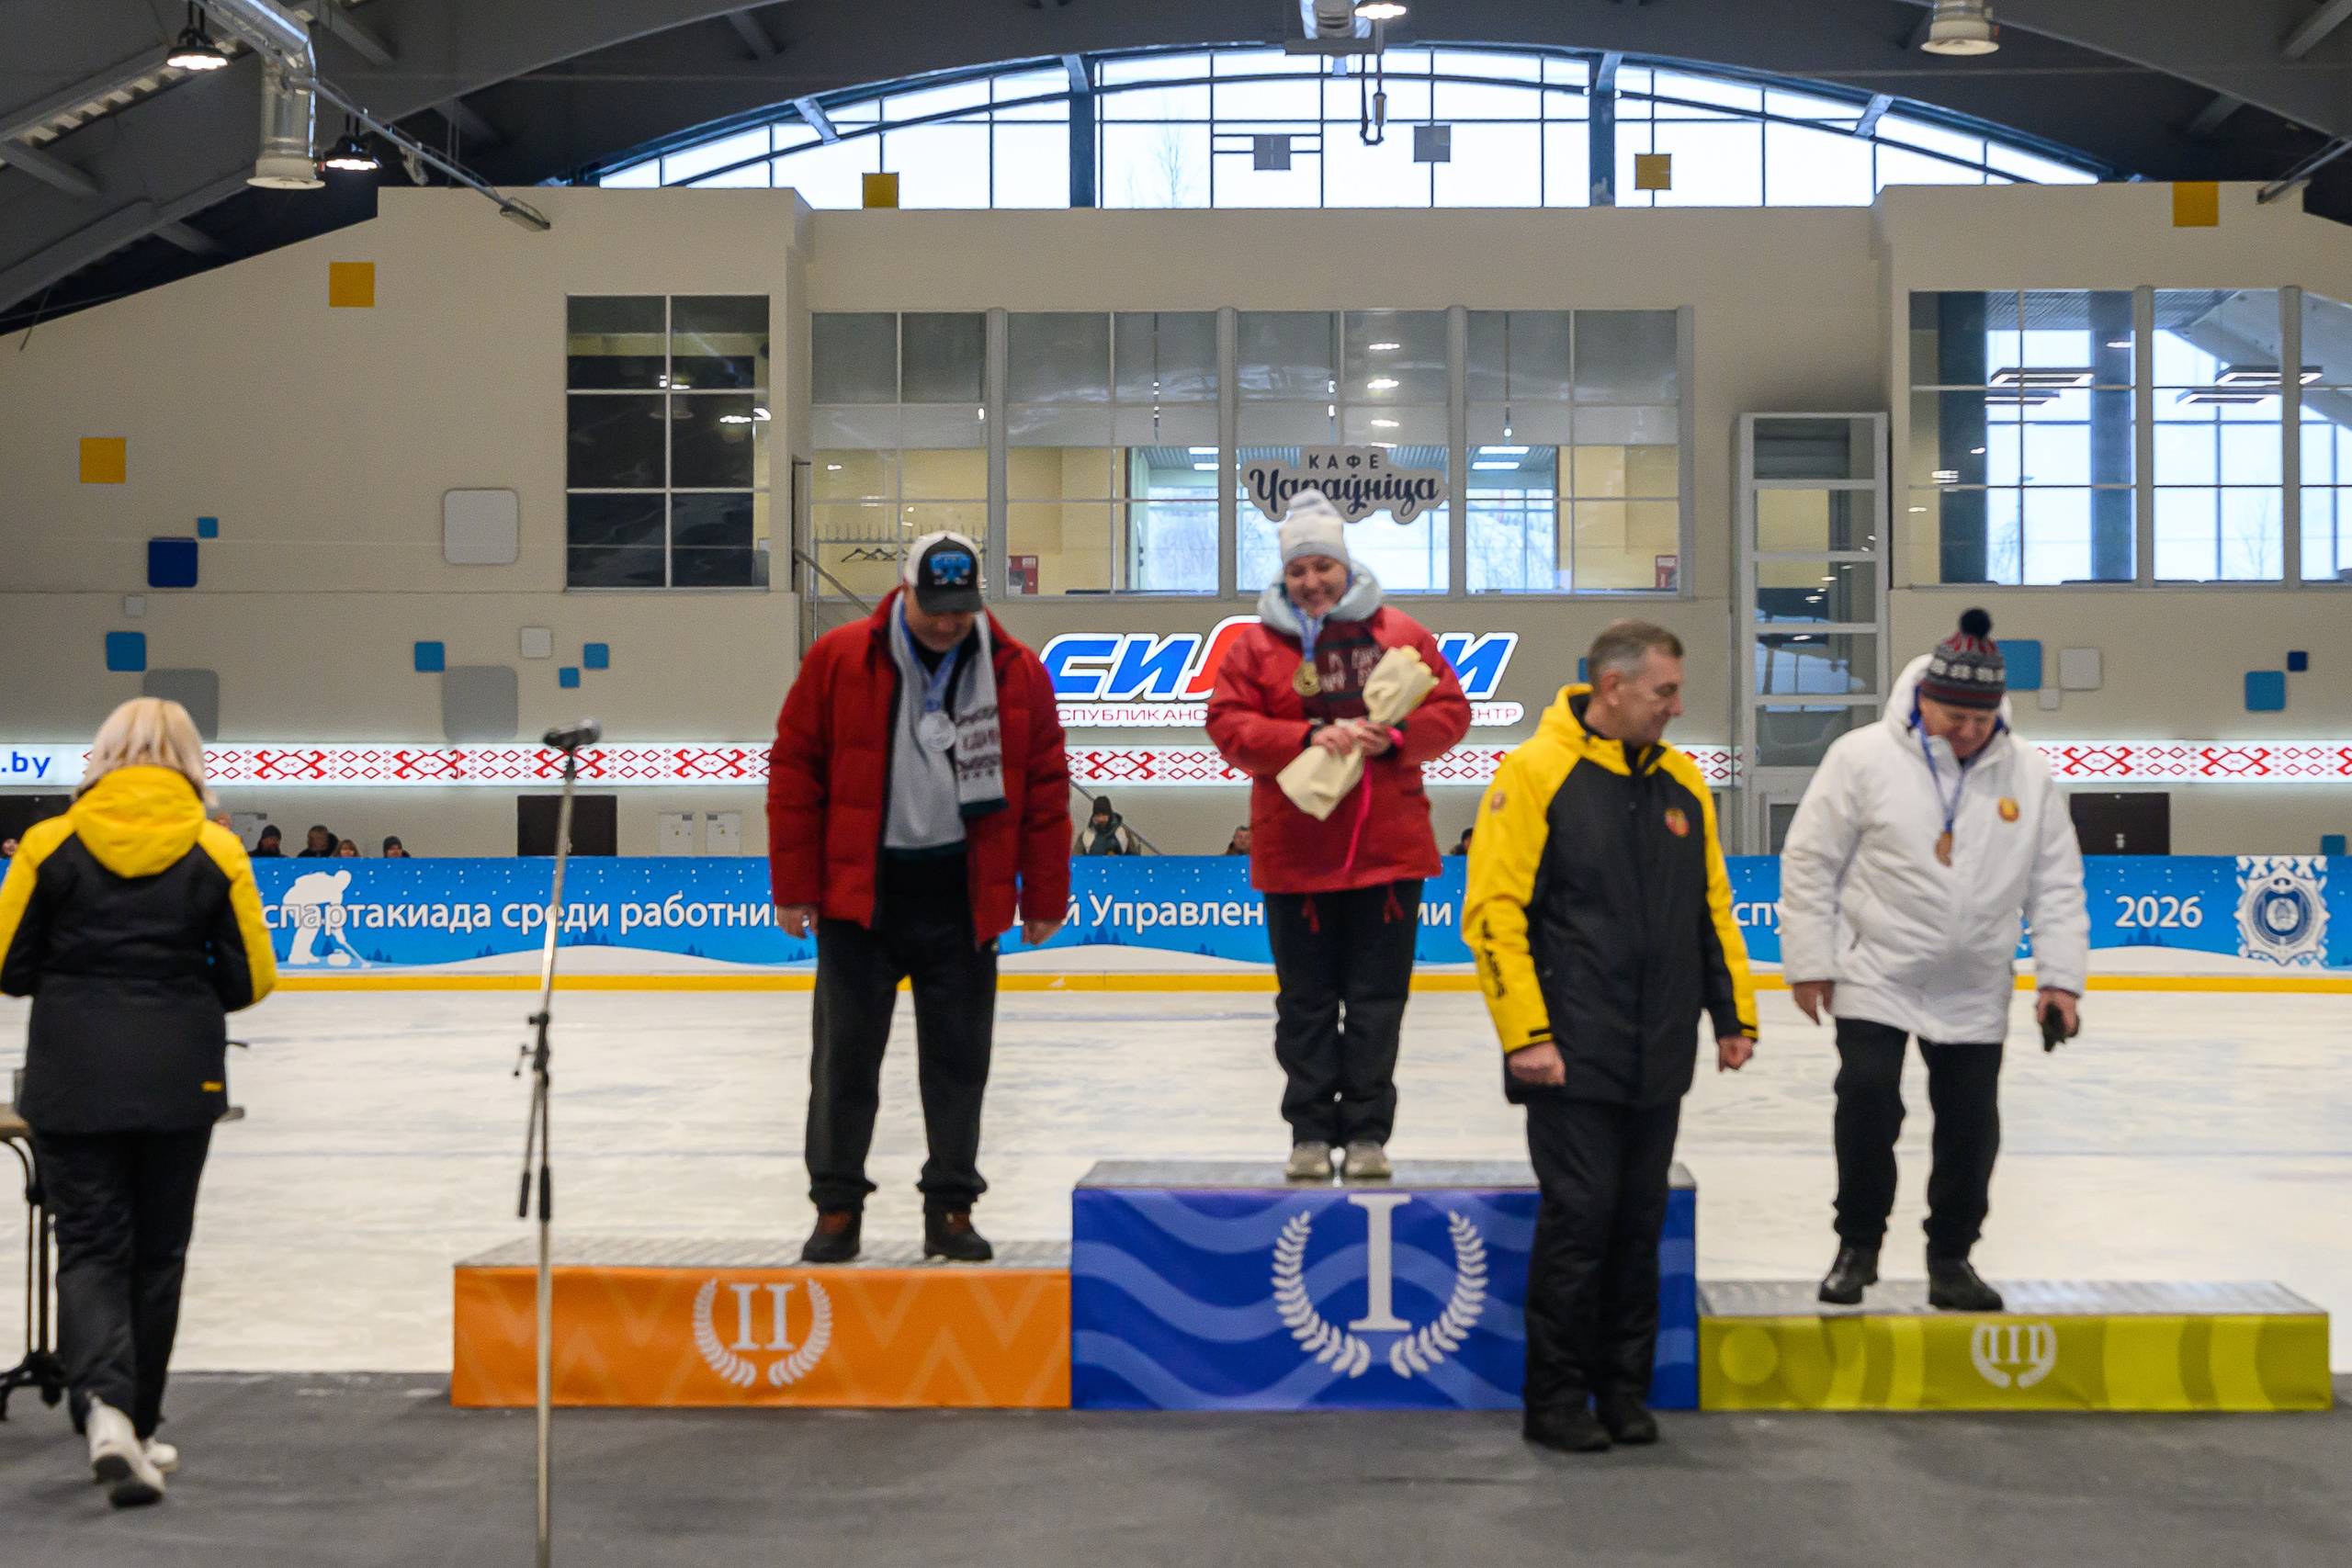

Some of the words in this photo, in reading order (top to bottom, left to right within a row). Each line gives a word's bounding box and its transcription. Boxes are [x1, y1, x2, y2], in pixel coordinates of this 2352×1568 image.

[1308, 454, 1379, 469] КАФЕ
[263, 903, 492, 936] спартакиада
[620, 893, 779, 935] работни
[2115, 895, 2203, 928] 2026
[1348, 1194, 1412, 1331] I
[728, 1283, 797, 1350] II
[1987, 1325, 2040, 1364] III
